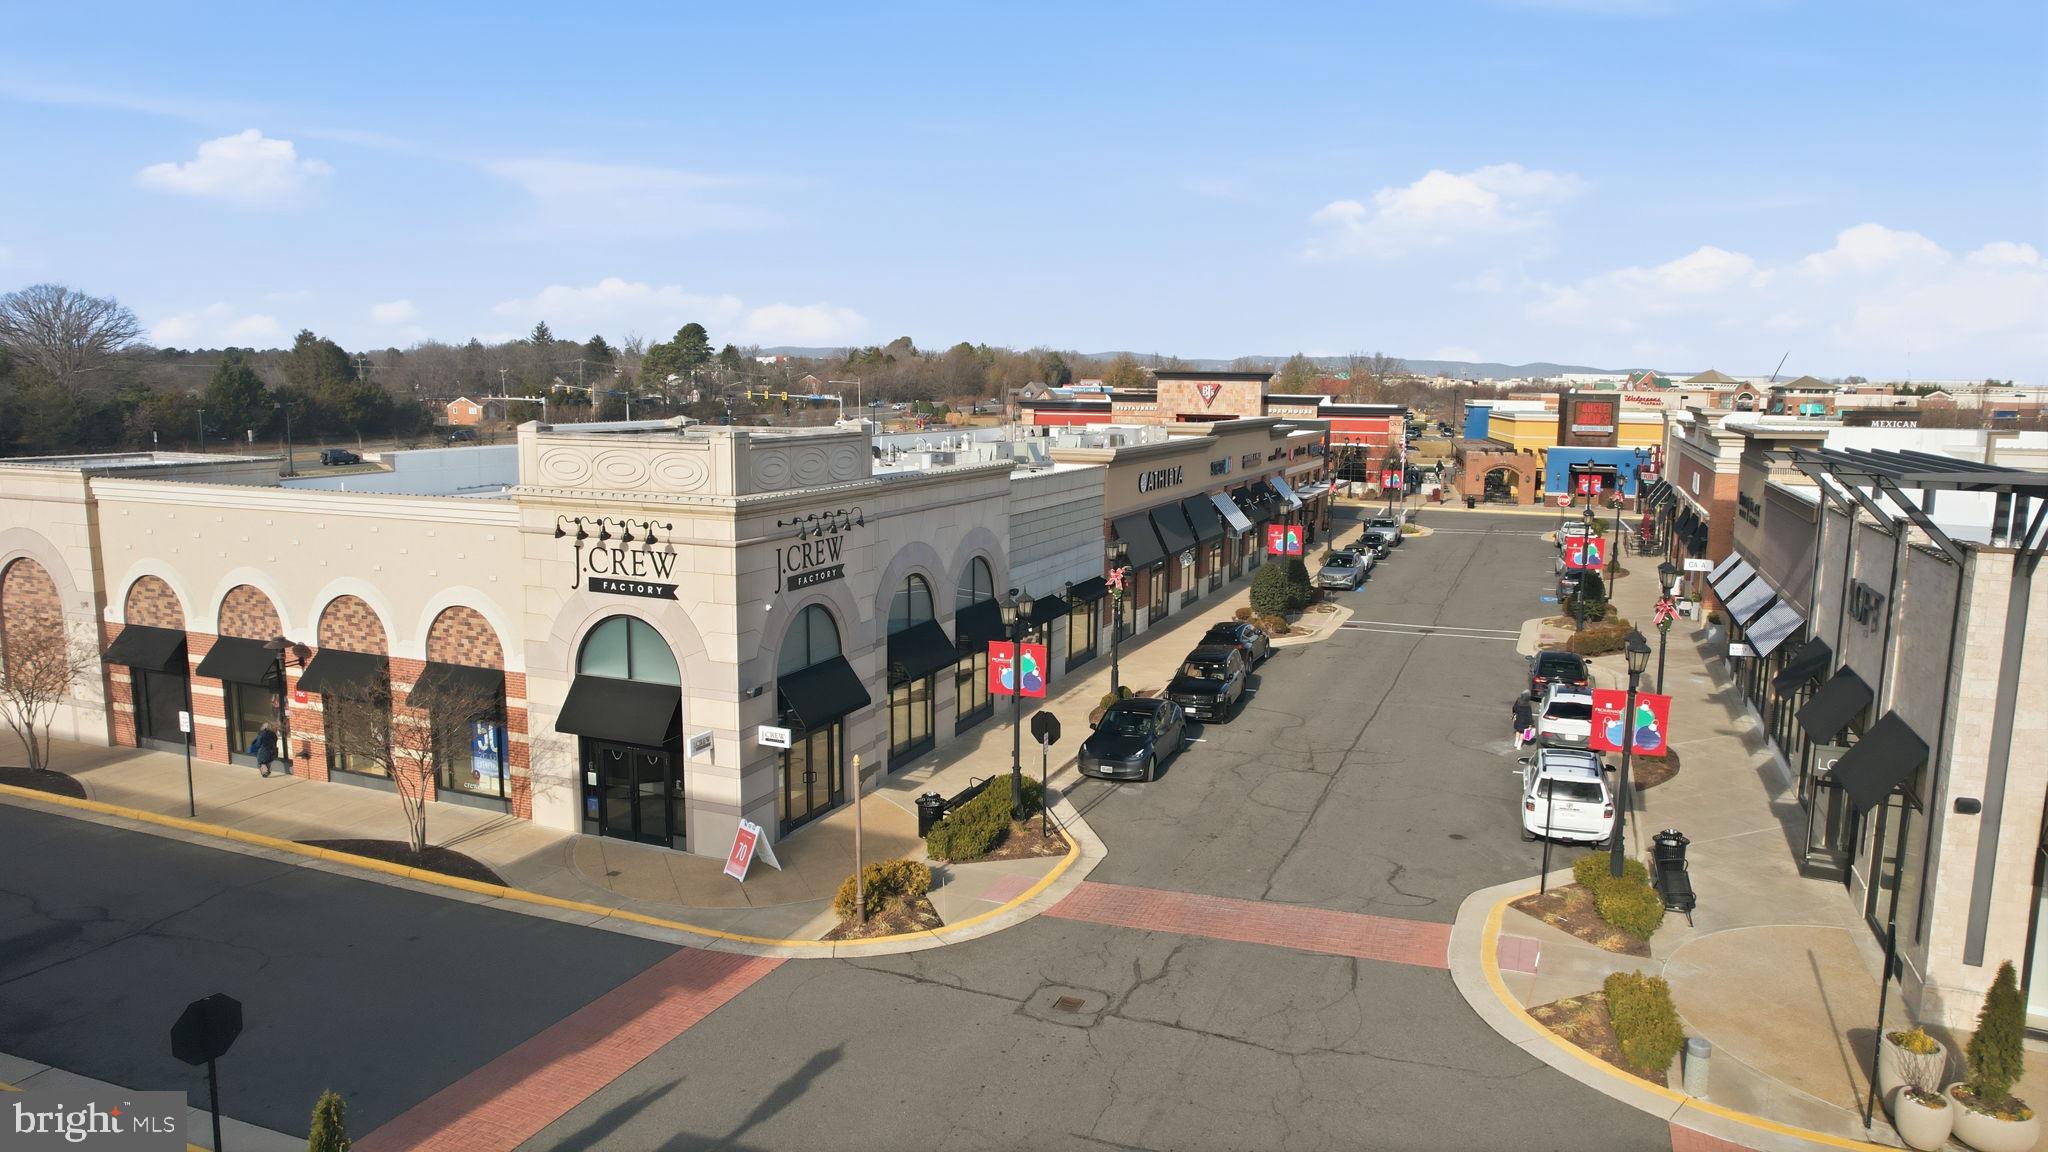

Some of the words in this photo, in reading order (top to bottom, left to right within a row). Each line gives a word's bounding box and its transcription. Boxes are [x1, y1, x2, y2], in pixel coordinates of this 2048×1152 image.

[1624, 395, 1662, 404] Walgreens
[1871, 420, 1918, 428] MEXICAN
[1145, 465, 1184, 492] ATHLETA
[571, 545, 678, 590] J.CREW
[774, 535, 844, 595] J.CREW
[798, 568, 837, 586] FACTORY
[602, 580, 663, 595] FACTORY
[735, 841, 748, 861] 70
